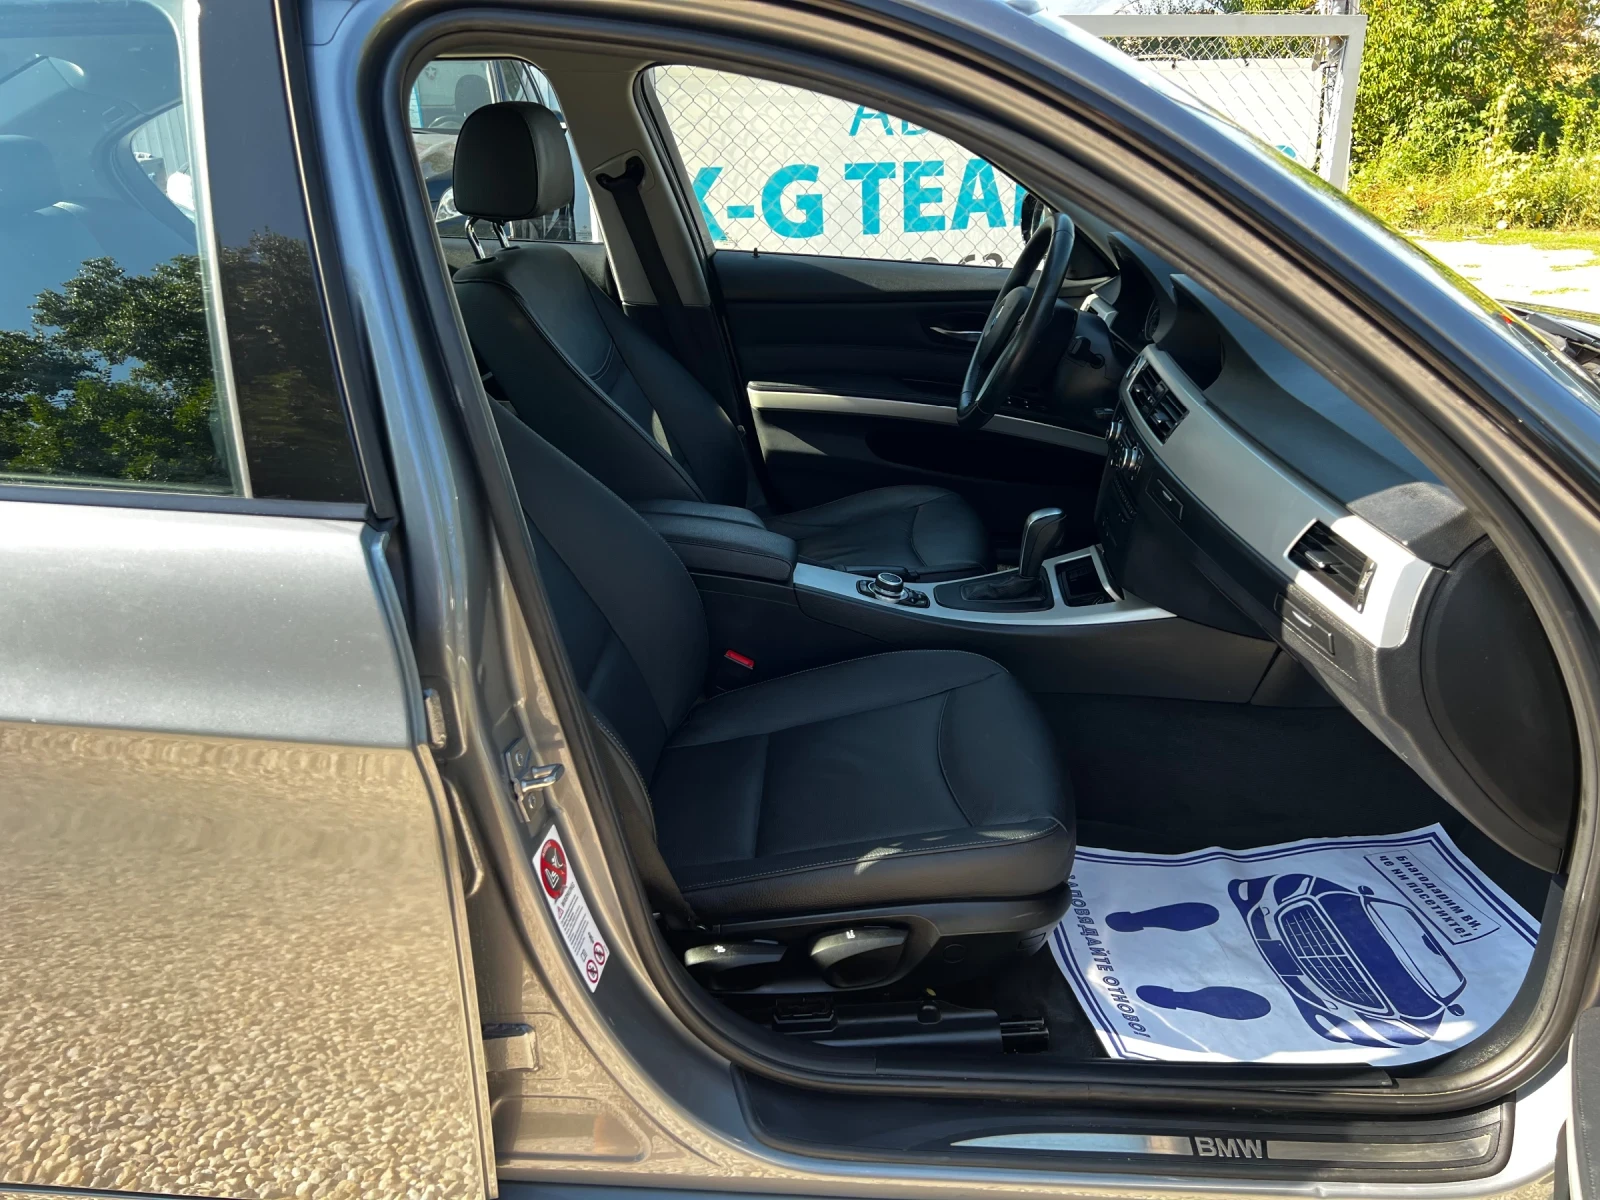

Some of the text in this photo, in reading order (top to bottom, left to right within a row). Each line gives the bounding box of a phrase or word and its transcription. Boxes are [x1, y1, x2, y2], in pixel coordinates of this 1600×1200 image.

[844, 158, 1029, 236] TEA
[1379, 855, 1473, 938] че ни посетихте!
[1395, 855, 1465, 915] Благодарим
[1102, 975, 1151, 1038] ОТНОВО!
[1194, 1136, 1263, 1159] BMW
